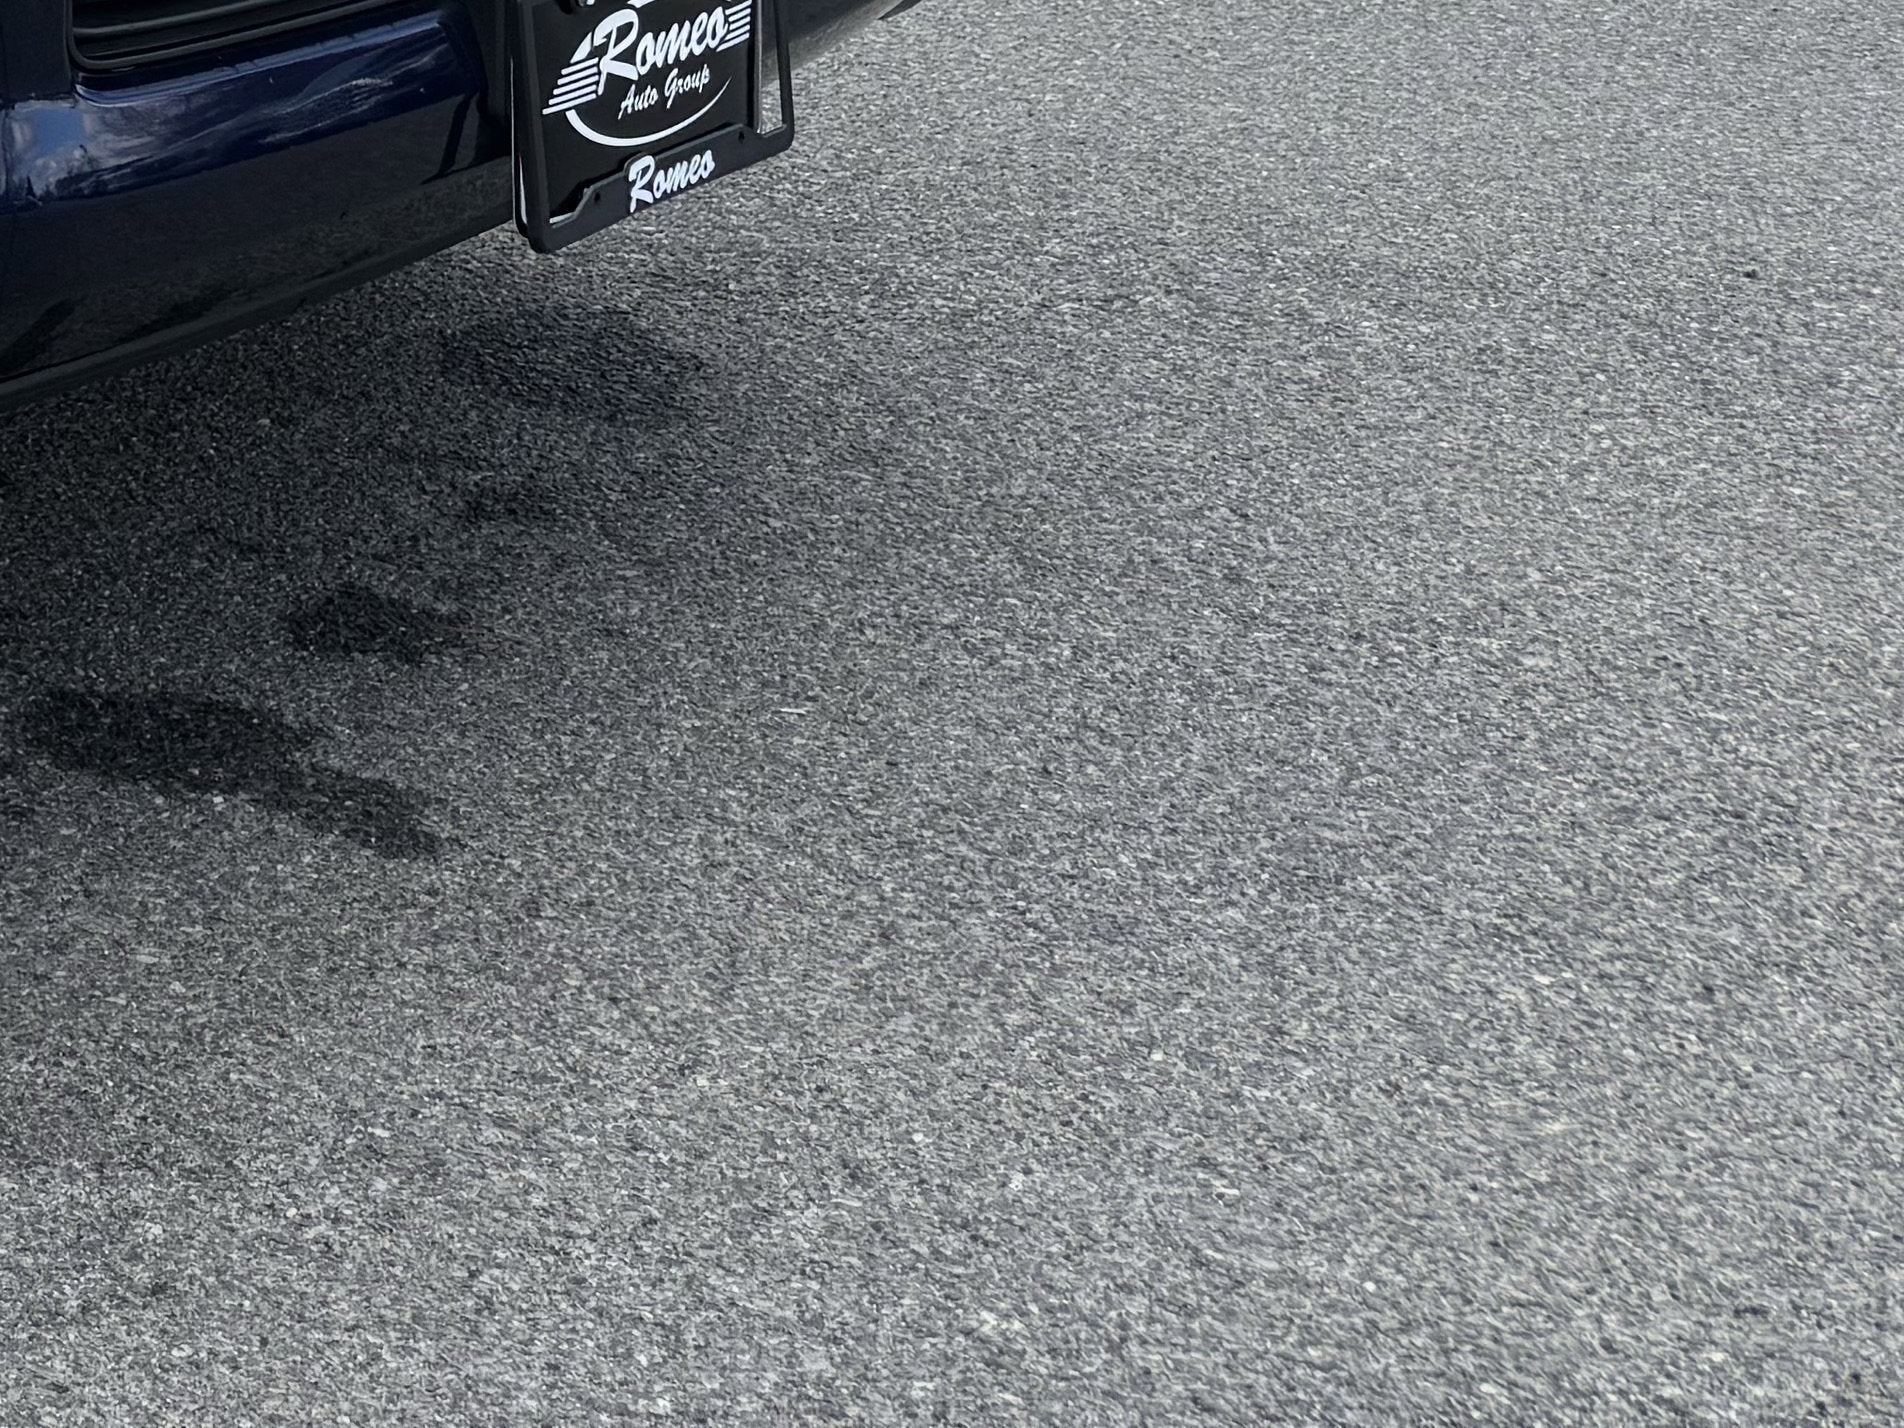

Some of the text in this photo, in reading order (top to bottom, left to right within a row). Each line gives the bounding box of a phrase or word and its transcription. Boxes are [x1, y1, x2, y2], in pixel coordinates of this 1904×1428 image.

[593, 6, 729, 95] Romeo
[618, 64, 710, 120] Auto Group
[628, 149, 716, 213] Romeo
